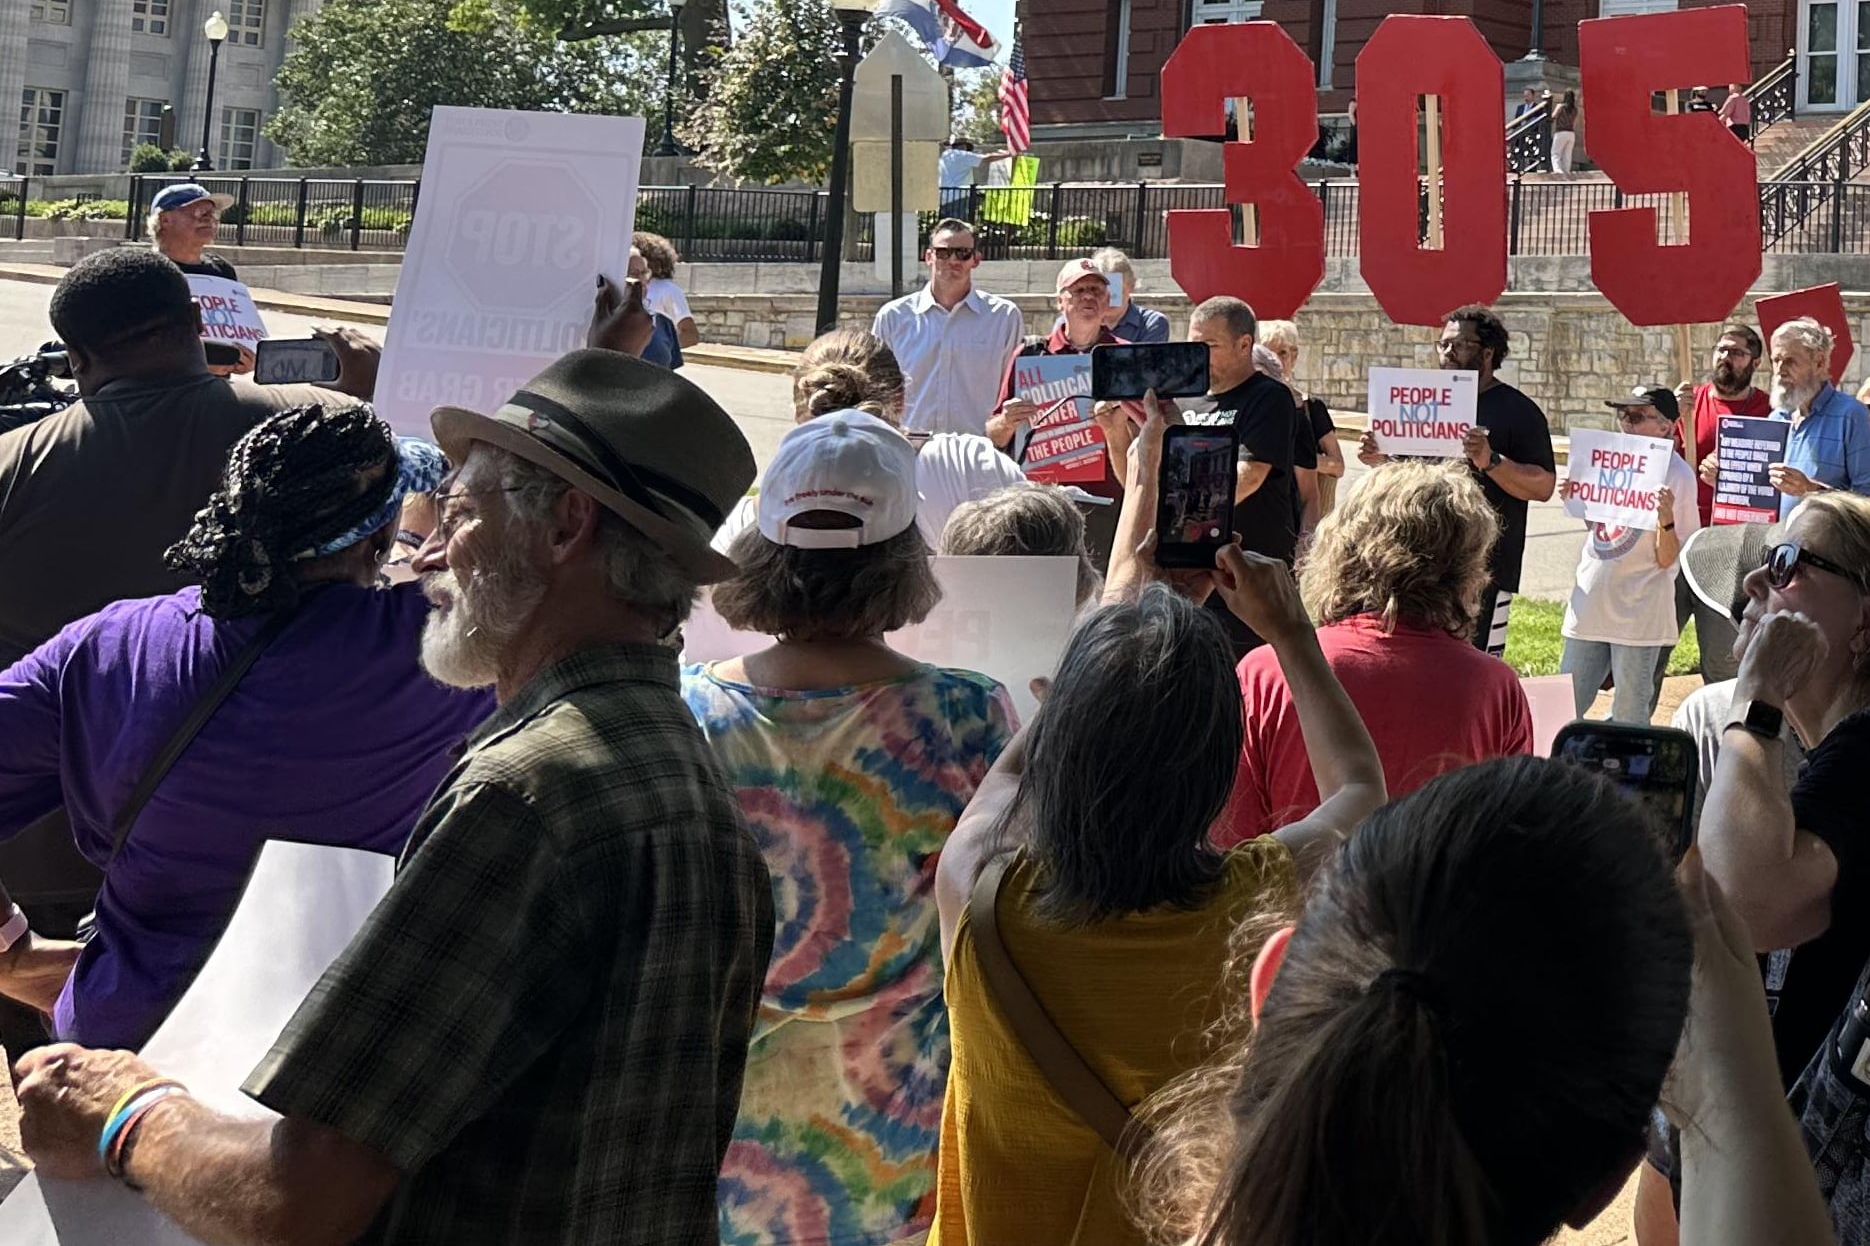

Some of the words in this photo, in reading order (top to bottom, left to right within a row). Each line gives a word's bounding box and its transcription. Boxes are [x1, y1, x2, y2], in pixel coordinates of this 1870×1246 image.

[1017, 365, 1044, 388] ALL
[1390, 386, 1452, 406] PEOPLE
[1400, 401, 1442, 425] NOT
[1372, 419, 1471, 440] POLITICIANS
[1027, 443, 1051, 462] THE
[1051, 429, 1094, 455] PEOPLE
[1591, 449, 1648, 474] PEOPLE
[1598, 468, 1640, 490] NOT
[1569, 481, 1657, 511] POLITICIANS
